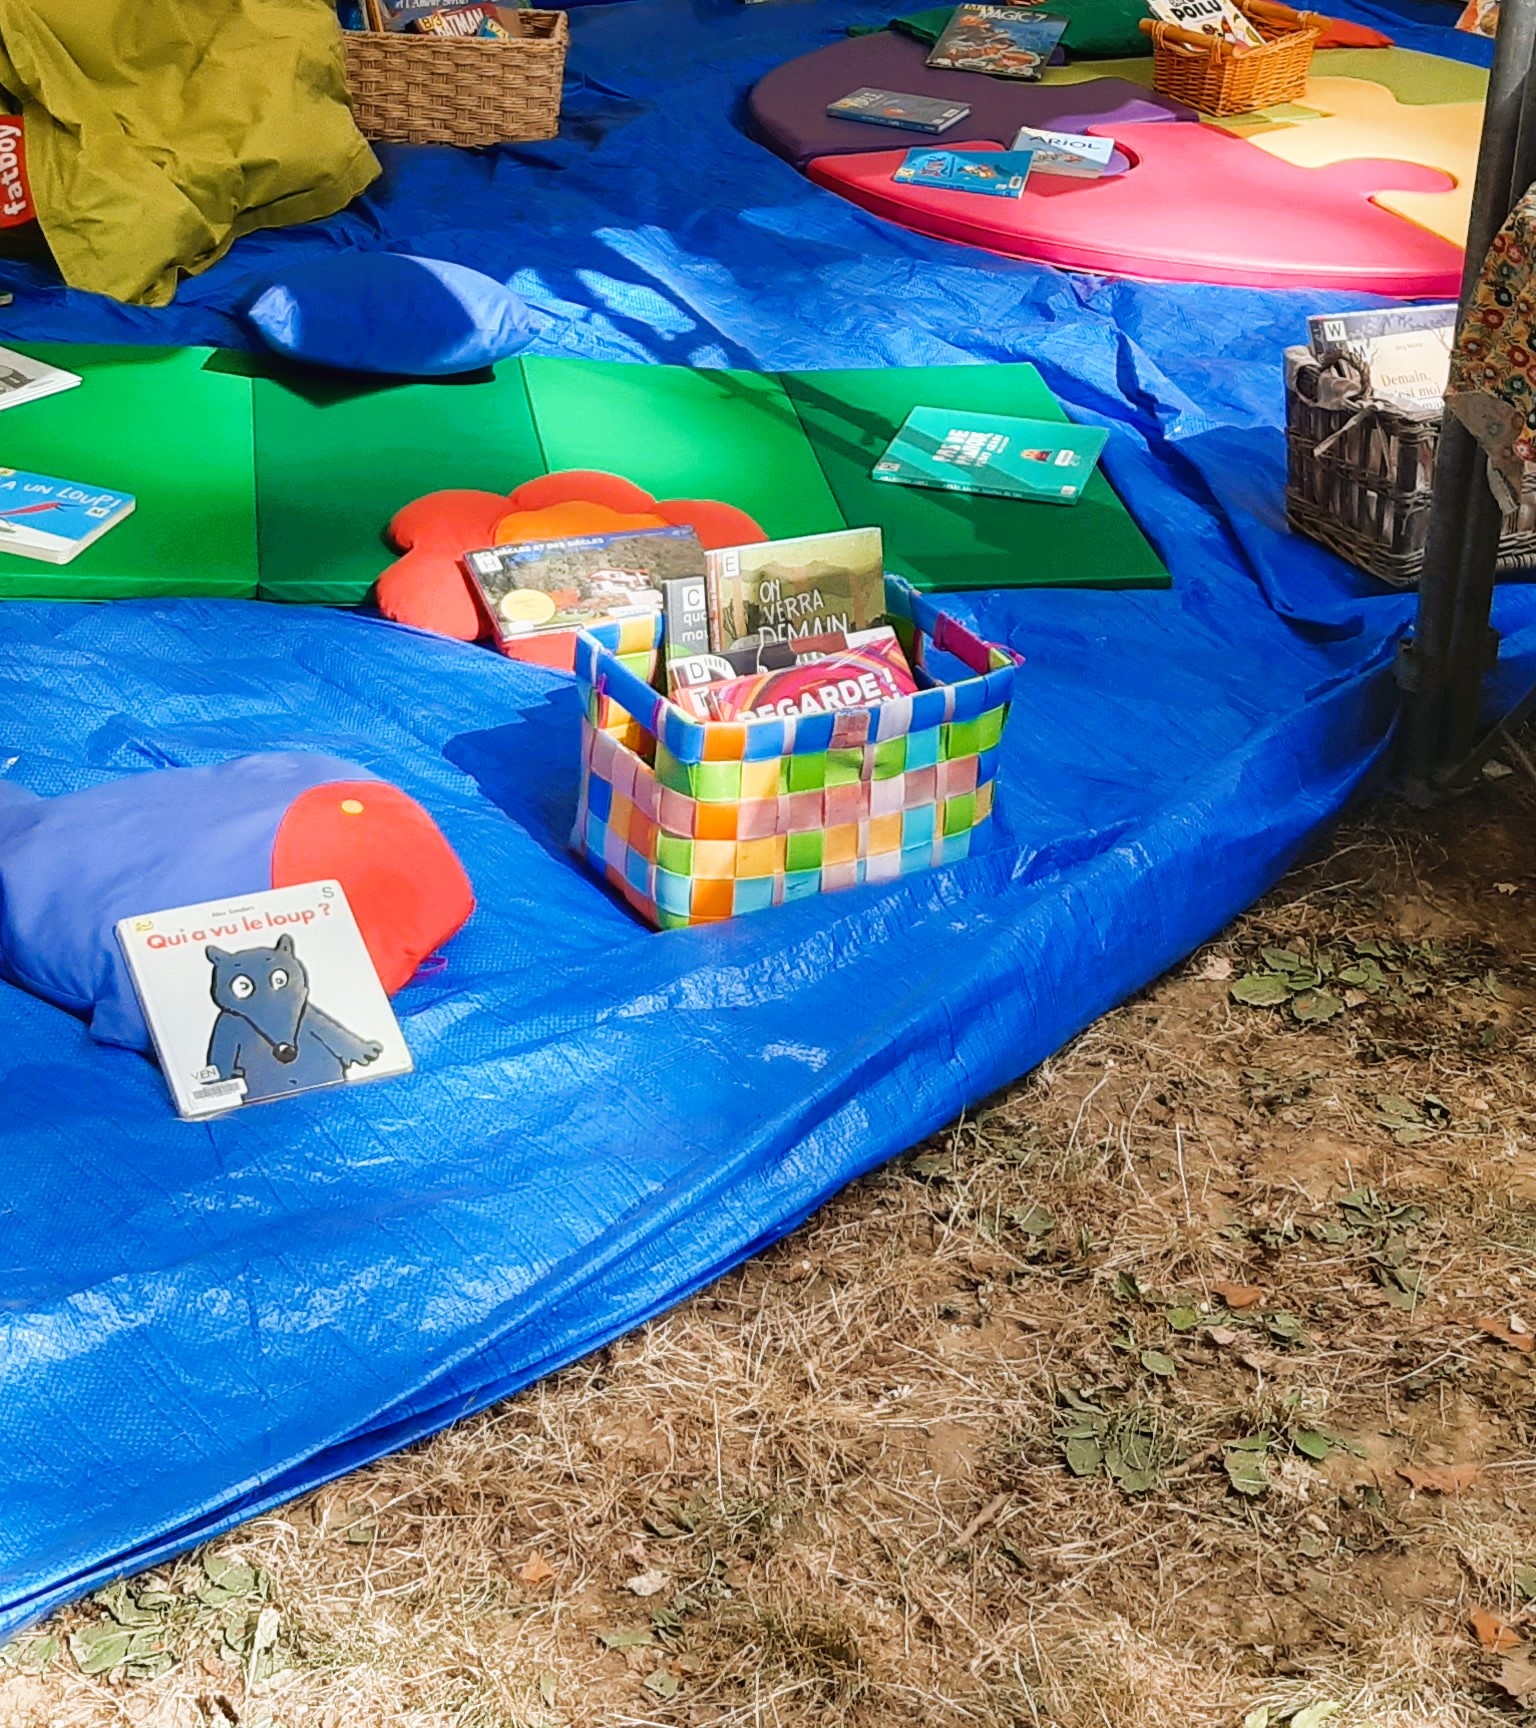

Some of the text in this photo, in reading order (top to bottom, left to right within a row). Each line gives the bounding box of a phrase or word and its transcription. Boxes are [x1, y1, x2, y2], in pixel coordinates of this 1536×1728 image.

[1029, 135, 1102, 151] ARIOL
[1327, 322, 1342, 337] W
[1380, 370, 1432, 388] Demain,
[1418, 383, 1441, 397] moi
[0, 480, 15, 490] A
[23, 483, 53, 495] UN
[725, 556, 737, 572] E
[687, 589, 700, 607] C
[760, 579, 781, 604] ON
[762, 589, 824, 625] VERRA
[758, 613, 848, 643] DEMAIN
[691, 661, 704, 680] D
[321, 886, 334, 899] S
[146, 902, 332, 950] Qui a vu le loup ?
[190, 1068, 217, 1082] VEN
